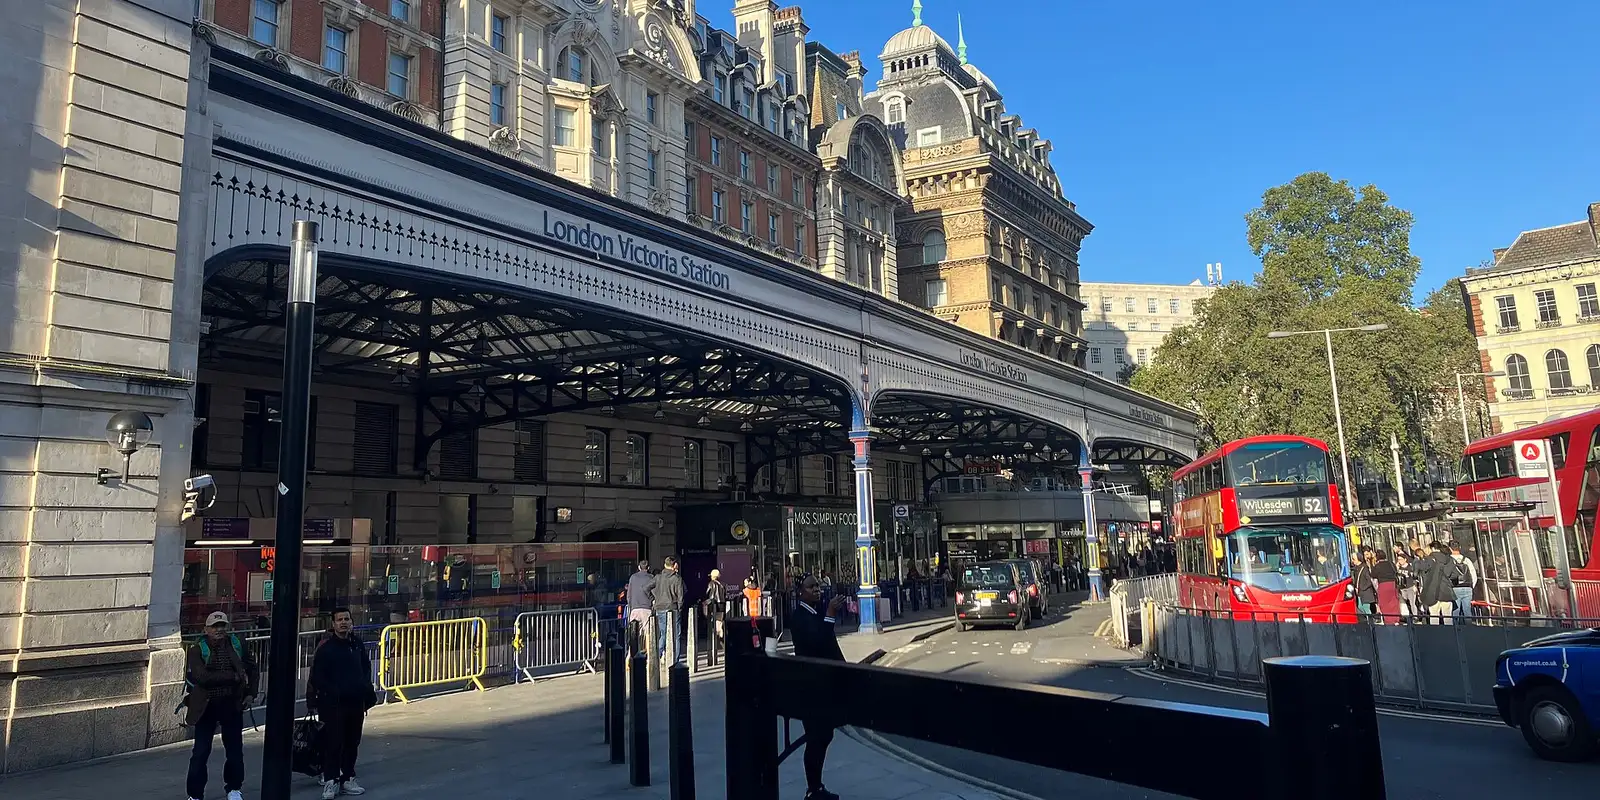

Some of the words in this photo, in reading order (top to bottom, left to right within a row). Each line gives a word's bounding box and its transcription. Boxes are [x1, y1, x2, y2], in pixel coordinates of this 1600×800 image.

[544, 210, 613, 255] London
[618, 234, 677, 275] Victoria
[680, 255, 730, 290] Station
[959, 348, 984, 370] London
[984, 357, 1007, 377] Victoria
[1007, 364, 1028, 383] Station
[1526, 447, 1536, 457] A
[1244, 500, 1292, 509] Willesden
[1304, 498, 1321, 512] 52
[794, 512, 811, 525] M&S
[812, 512, 838, 526] SIMPLY
[839, 513, 858, 526] FOOD
[260, 547, 276, 559] KIN
[1281, 594, 1313, 602] Metroline
